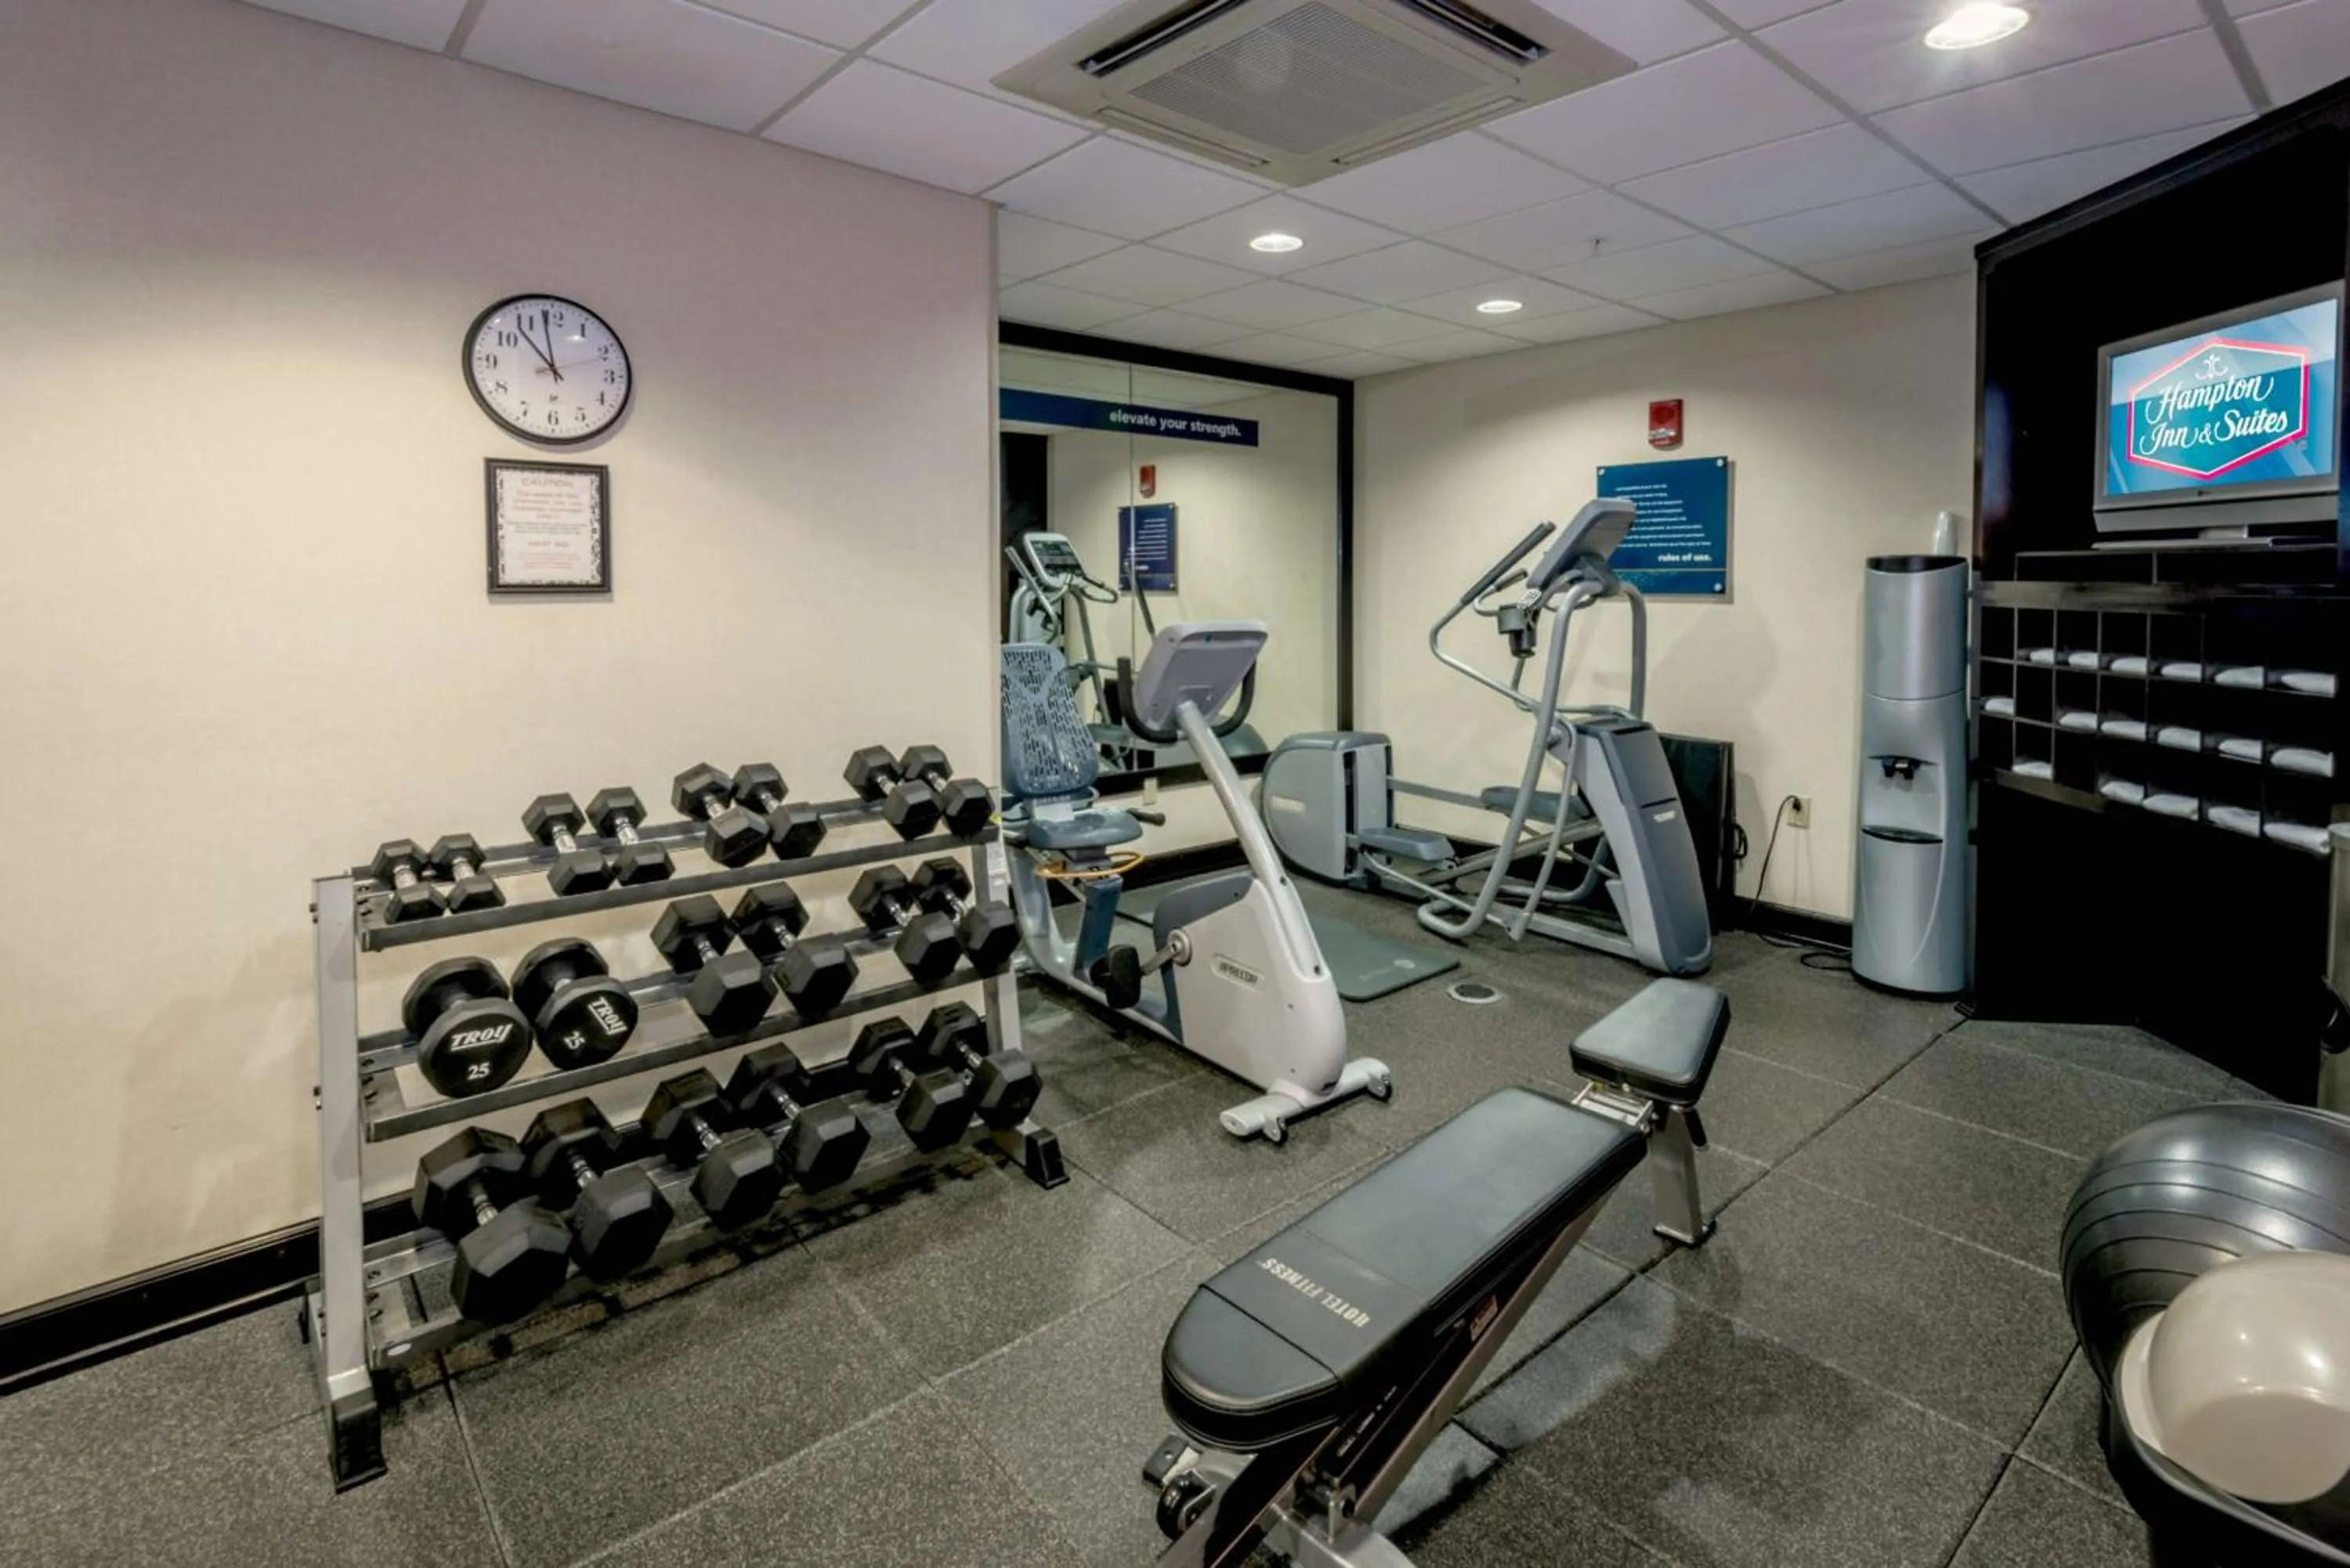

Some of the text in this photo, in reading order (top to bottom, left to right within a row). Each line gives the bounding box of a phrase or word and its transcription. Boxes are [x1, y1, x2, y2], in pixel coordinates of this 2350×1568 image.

[580, 323, 586, 338] 1
[497, 331, 518, 348] 10
[486, 353, 497, 369] 9
[598, 345, 609, 361] 2
[604, 370, 615, 384] 3
[495, 381, 508, 393] 8
[595, 391, 605, 406] 4
[2146, 374, 2273, 424] Hampton
[520, 400, 529, 417] 7
[575, 406, 586, 422] 5
[548, 410, 559, 425] 6
[1109, 409, 1241, 438] elevate your strength.
[2140, 408, 2287, 455] Inn & Suites
[1658, 552, 1679, 562] rules
[1681, 552, 1692, 562] of
[588, 996, 627, 1035] TROY
[450, 1023, 513, 1052] TROY
[563, 1031, 586, 1050] 25
[468, 1062, 490, 1080] 25
[1261, 1257, 1371, 1328] HOTEL FITNESS
